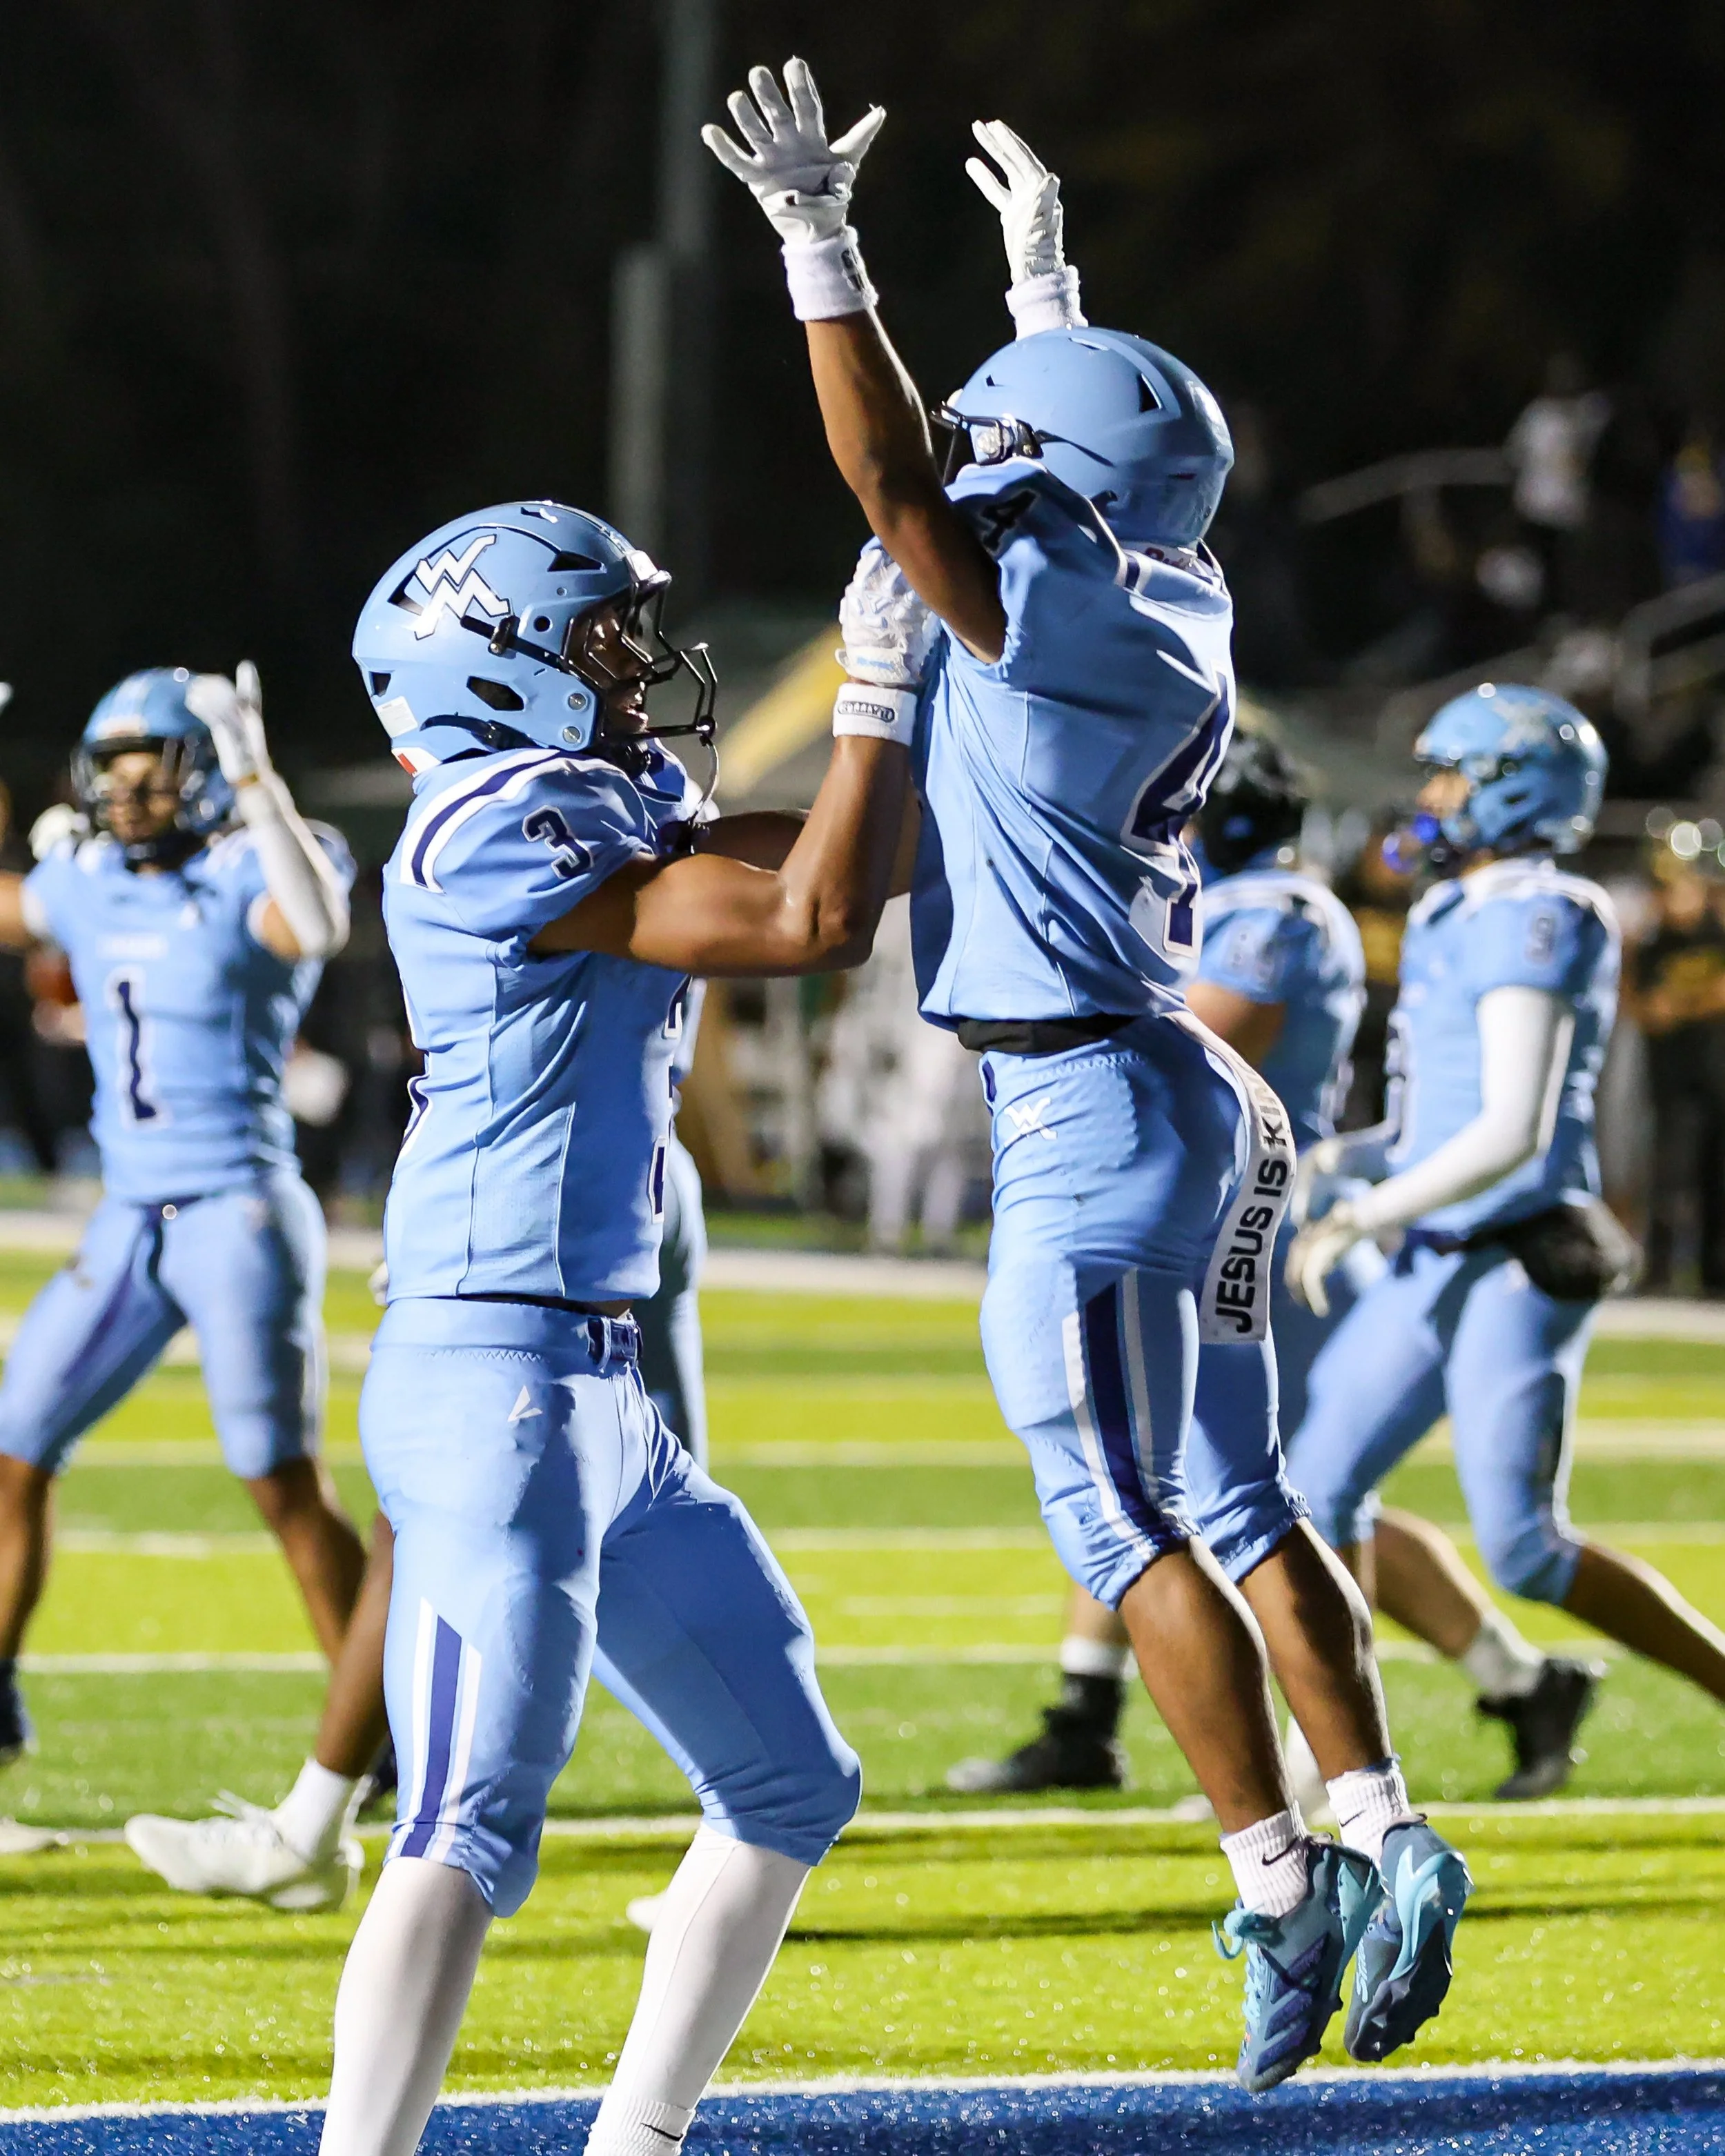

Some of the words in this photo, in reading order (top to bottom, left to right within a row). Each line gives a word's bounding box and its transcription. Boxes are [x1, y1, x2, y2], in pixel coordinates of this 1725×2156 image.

[522, 804, 593, 878] 3
[108, 971, 164, 1127] 1
[1214, 1205, 1274, 1334] JESUS
[1253, 1158, 1289, 1198] IS
